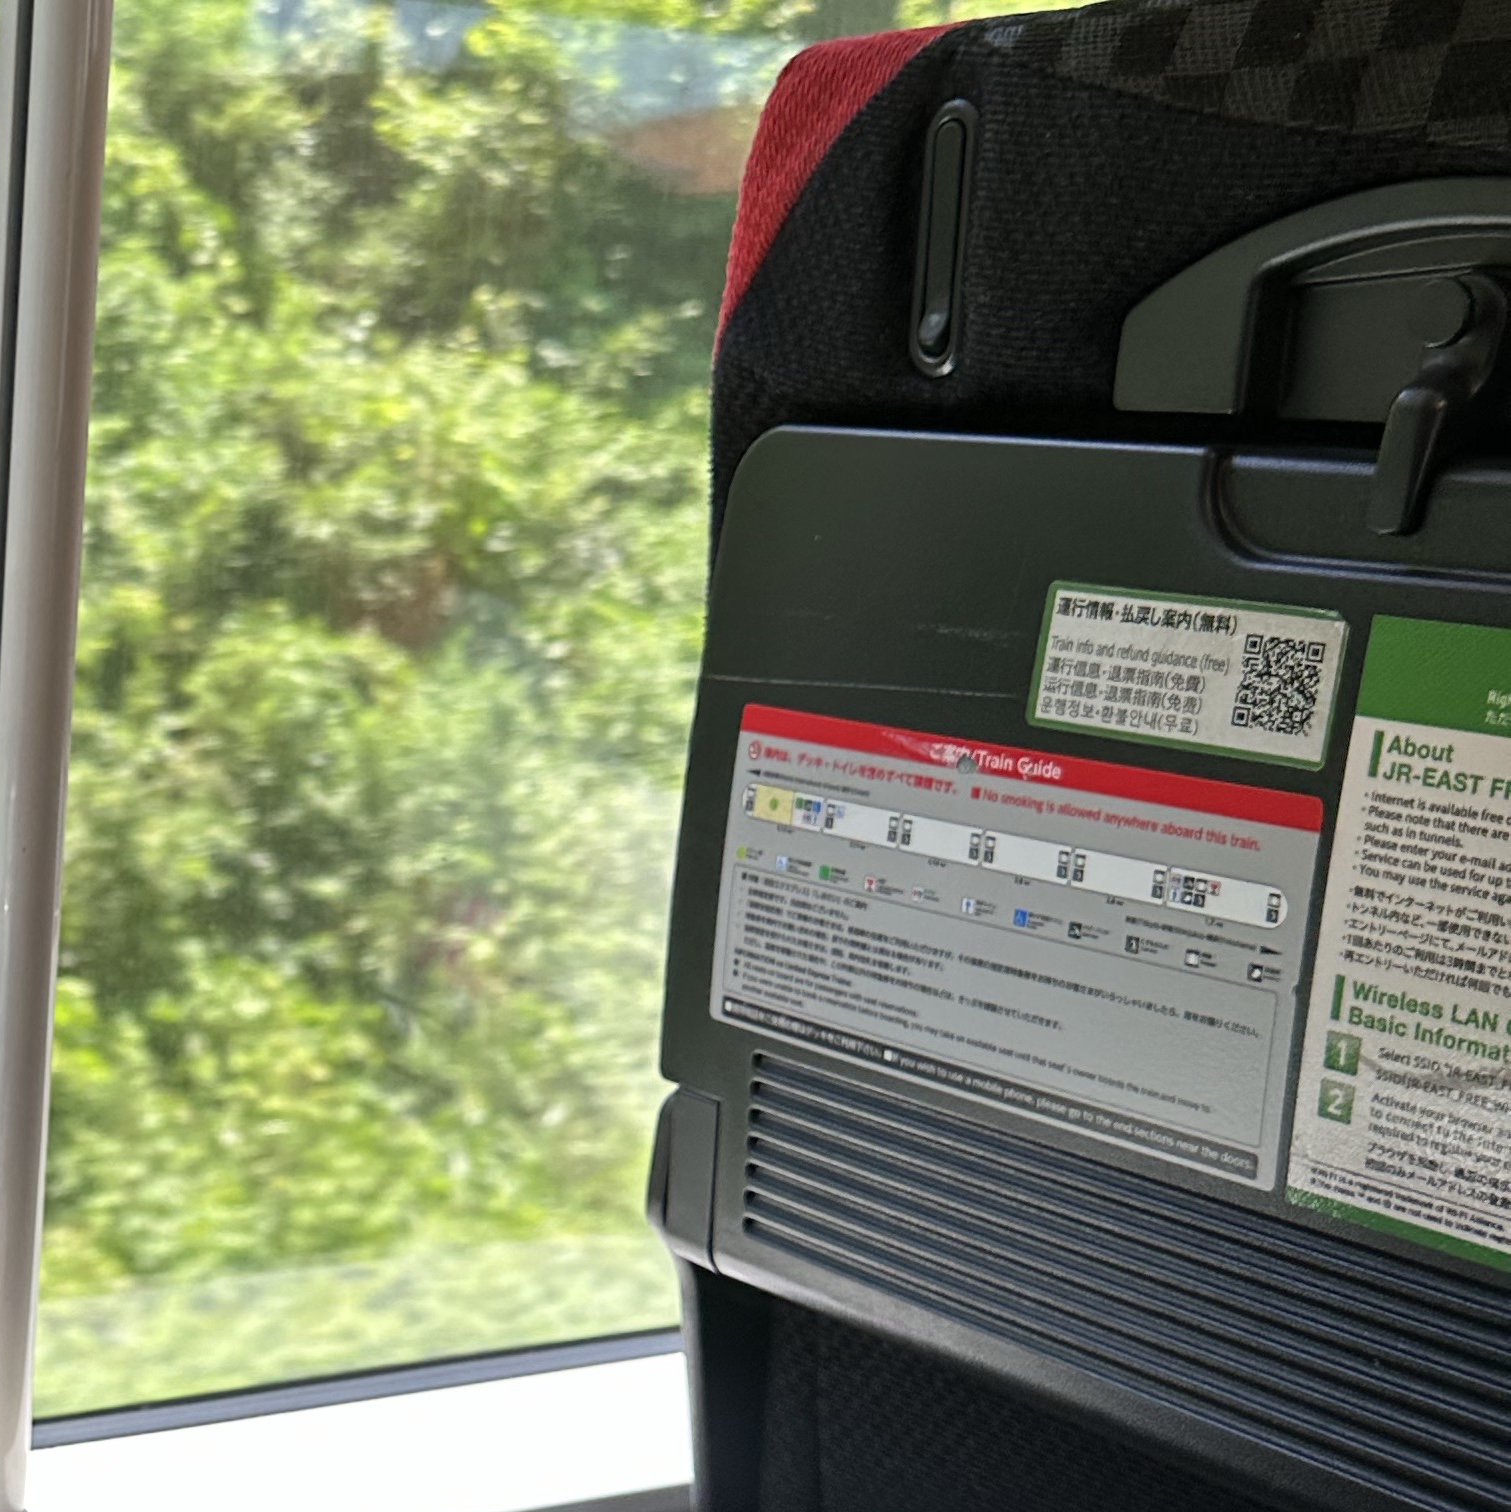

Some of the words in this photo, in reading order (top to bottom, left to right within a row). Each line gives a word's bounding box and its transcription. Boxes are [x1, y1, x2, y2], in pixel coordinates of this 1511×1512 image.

[1051, 635, 1073, 651] Train
[1075, 639, 1094, 654] info
[1095, 643, 1115, 657] and
[1116, 644, 1149, 662] refund
[1150, 650, 1197, 668] guidance
[1196, 653, 1232, 675] (free)
[1387, 735, 1453, 762] About
[1017, 757, 1061, 779] Guide
[1383, 762, 1483, 793] JR-EAST
[982, 788, 998, 802] No
[1000, 794, 1043, 813] smoking
[1045, 801, 1055, 813] is
[1057, 803, 1101, 821] allowed
[1104, 813, 1158, 832] anywhere
[1160, 822, 1203, 840] aboard
[1205, 829, 1227, 845] this
[1230, 834, 1260, 851] train.
[1367, 805, 1402, 821] Please
[1404, 813, 1430, 826] note
[1432, 817, 1455, 831] that
[1458, 821, 1488, 837] there
[1490, 829, 1509, 840] are
[1371, 791, 1415, 808] Internet
[1416, 798, 1425, 810] is
[1428, 803, 1478, 819] available
[1480, 808, 1503, 824] free
[1363, 821, 1389, 834] such
[1390, 827, 1403, 837] as
[1405, 826, 1416, 839] in
[1418, 830, 1463, 848] tunnels.
[1363, 834, 1397, 850] Please
[1400, 843, 1429, 856] enter
[1430, 849, 1457, 861] your
[1459, 854, 1496, 869] e-mail
[1359, 863, 1379, 877] You
[1382, 870, 1405, 884] may
[1408, 875, 1426, 887] use
[1429, 878, 1448, 891] the
[1450, 884, 1489, 899] service
[1361, 849, 1399, 866] Service
[1401, 859, 1421, 870] can
[1423, 860, 1437, 873] be
[1439, 866, 1466, 879] used
[1468, 868, 1485, 882] for
[1487, 875, 1503, 888] up
[1348, 1006, 1406, 1036] Basic
[1353, 981, 1443, 1018] Wireless
[1450, 1003, 1498, 1032] LAN
[1338, 1039, 1347, 1065] 1
[1378, 1047, 1410, 1065] Select
[1327, 1087, 1344, 1114] 2
